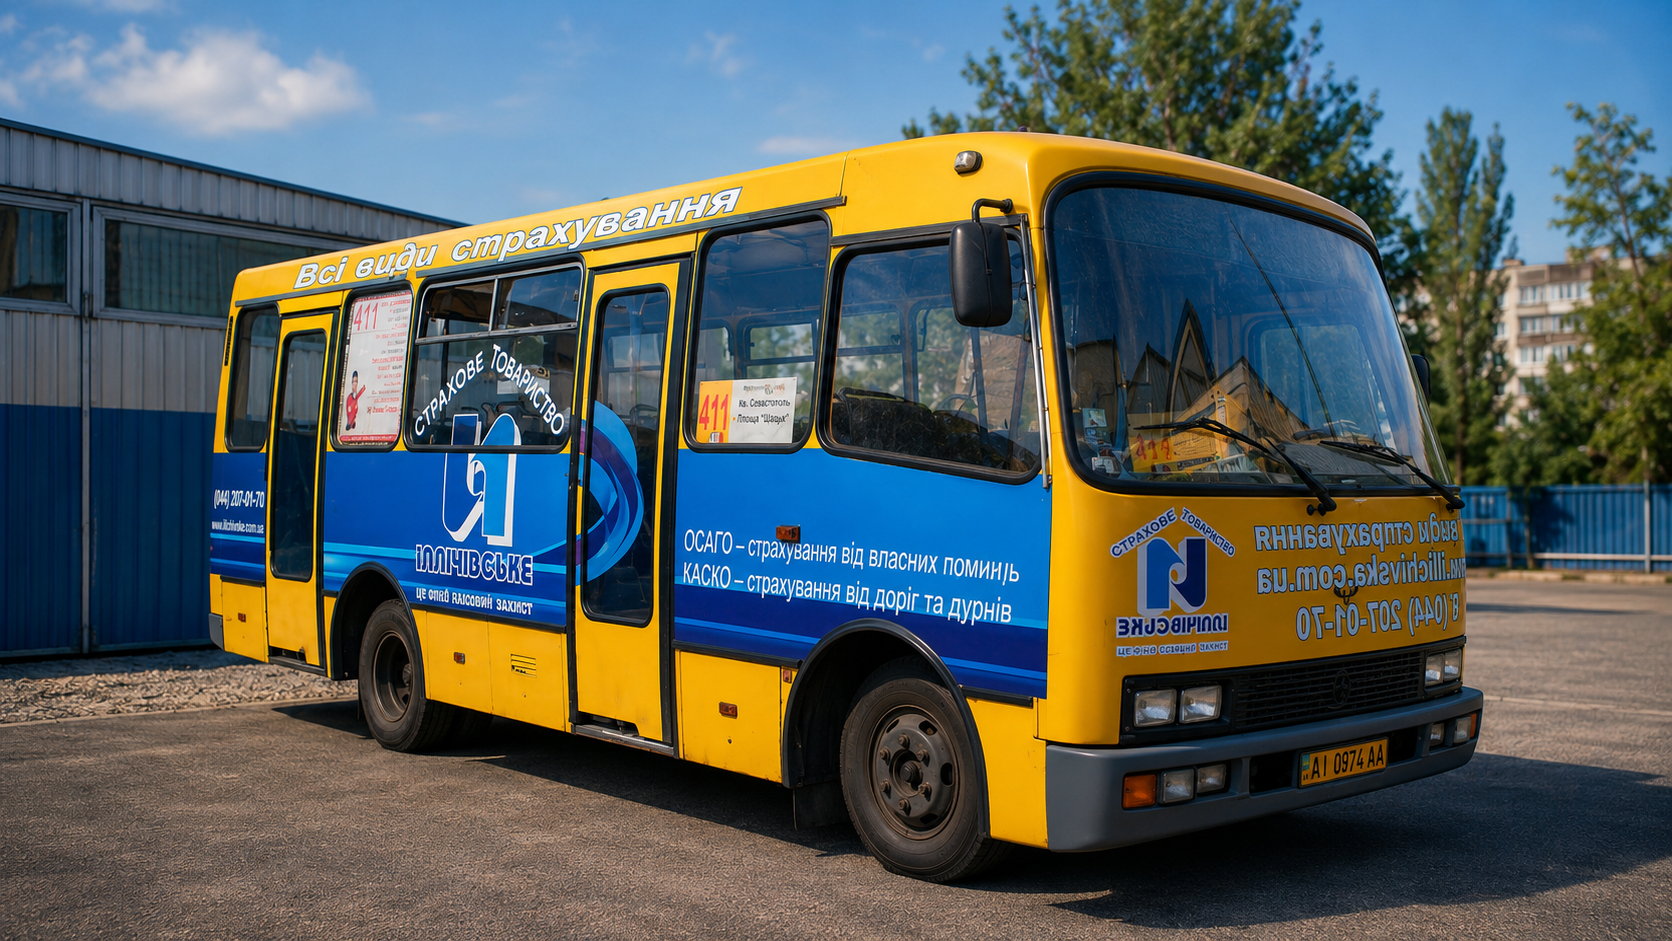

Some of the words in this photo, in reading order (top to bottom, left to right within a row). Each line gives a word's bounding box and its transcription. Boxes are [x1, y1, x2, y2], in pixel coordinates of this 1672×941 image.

[293, 256, 349, 289] Всі
[355, 242, 438, 278] види
[451, 186, 743, 262] страхування
[353, 302, 379, 331] 411
[414, 350, 485, 436] СТРАХОВЕ
[490, 343, 565, 435] ТОВАРИСТВО
[698, 393, 729, 431] 411
[213, 488, 230, 510] (044)
[230, 490, 265, 508] 207-01-70
[684, 529, 733, 555] ОСАГО
[748, 538, 837, 565] страхування
[841, 541, 864, 570] від
[869, 549, 938, 575] власних
[1111, 508, 1177, 557] СТРАХОВЕ
[415, 543, 534, 586] ІЛЛІЧІВСЬКЕ
[683, 561, 732, 589] КАСКО
[747, 573, 841, 602] страхування
[846, 580, 870, 610] від
[873, 586, 920, 616] доріг
[924, 594, 943, 615] та
[947, 596, 1012, 626] дурнів
[1311, 755, 1327, 780] AI
[1333, 747, 1364, 775] 0974
[1367, 744, 1384, 768] AA
